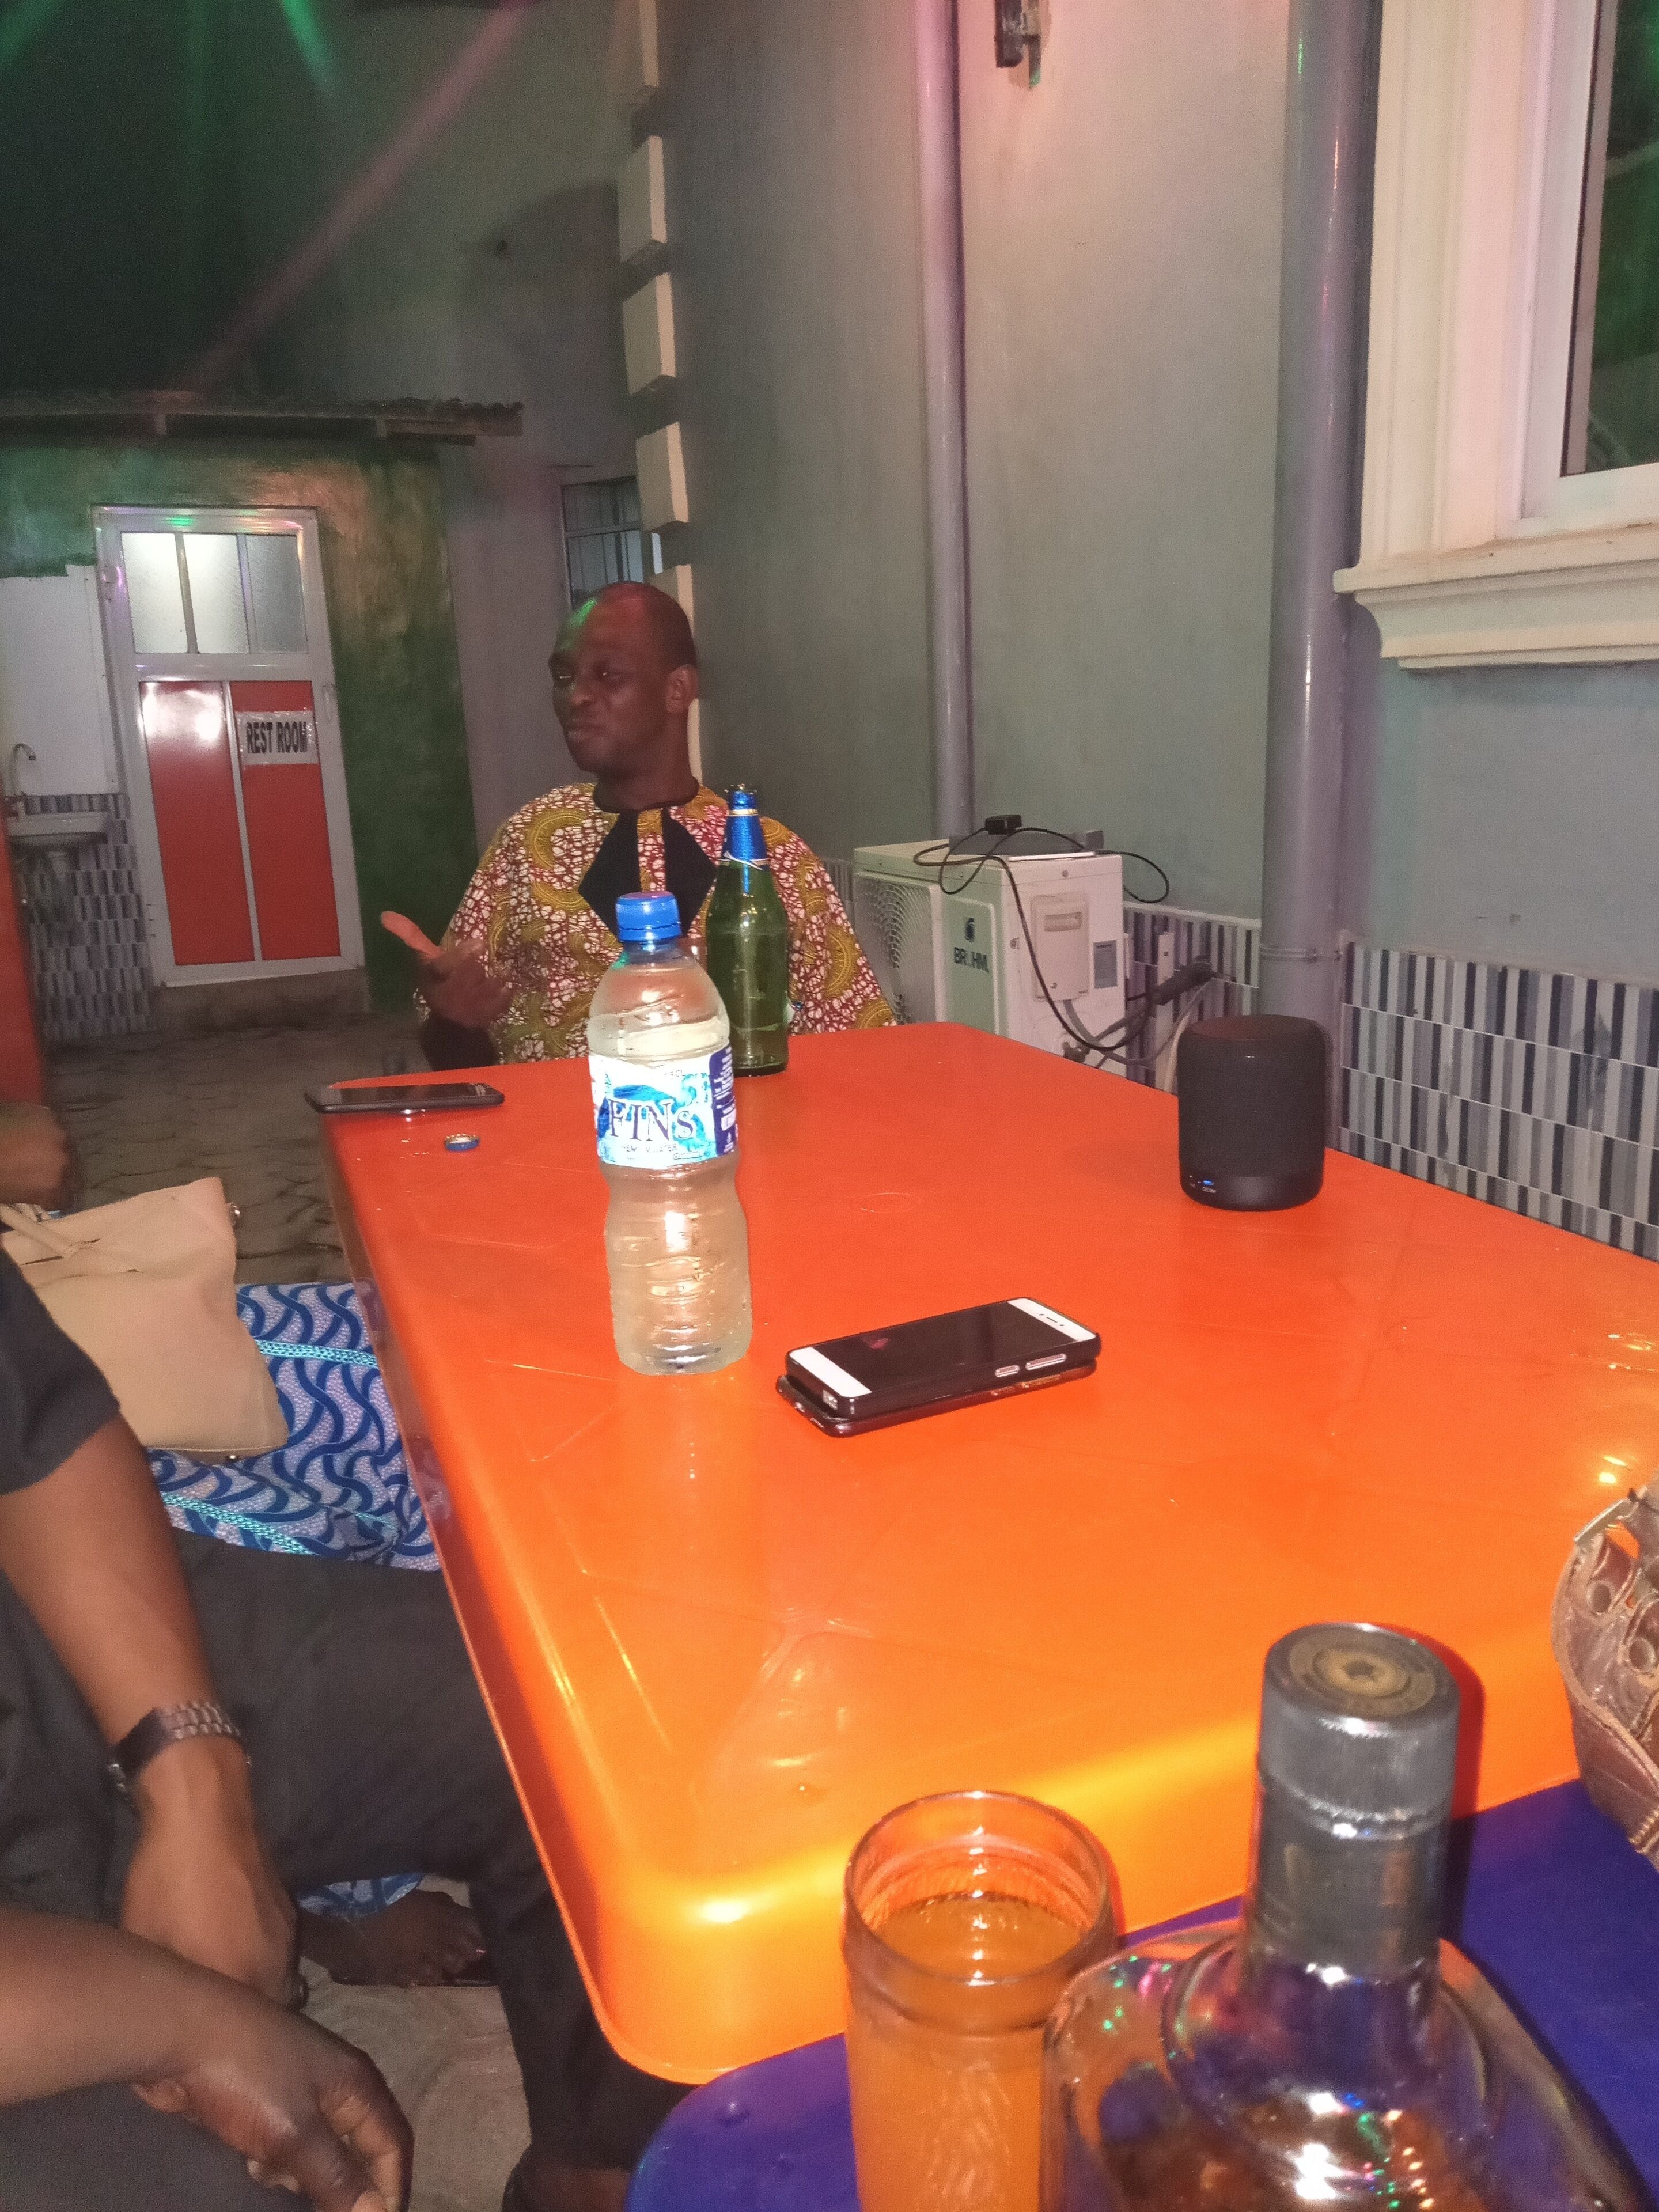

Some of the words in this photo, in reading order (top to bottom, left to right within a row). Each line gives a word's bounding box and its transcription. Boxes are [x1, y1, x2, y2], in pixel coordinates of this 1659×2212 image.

[246, 722, 273, 753] REST
[276, 721, 308, 753] ROOM
[953, 946, 989, 973] BRHM
[607, 1098, 694, 1142] FINS
